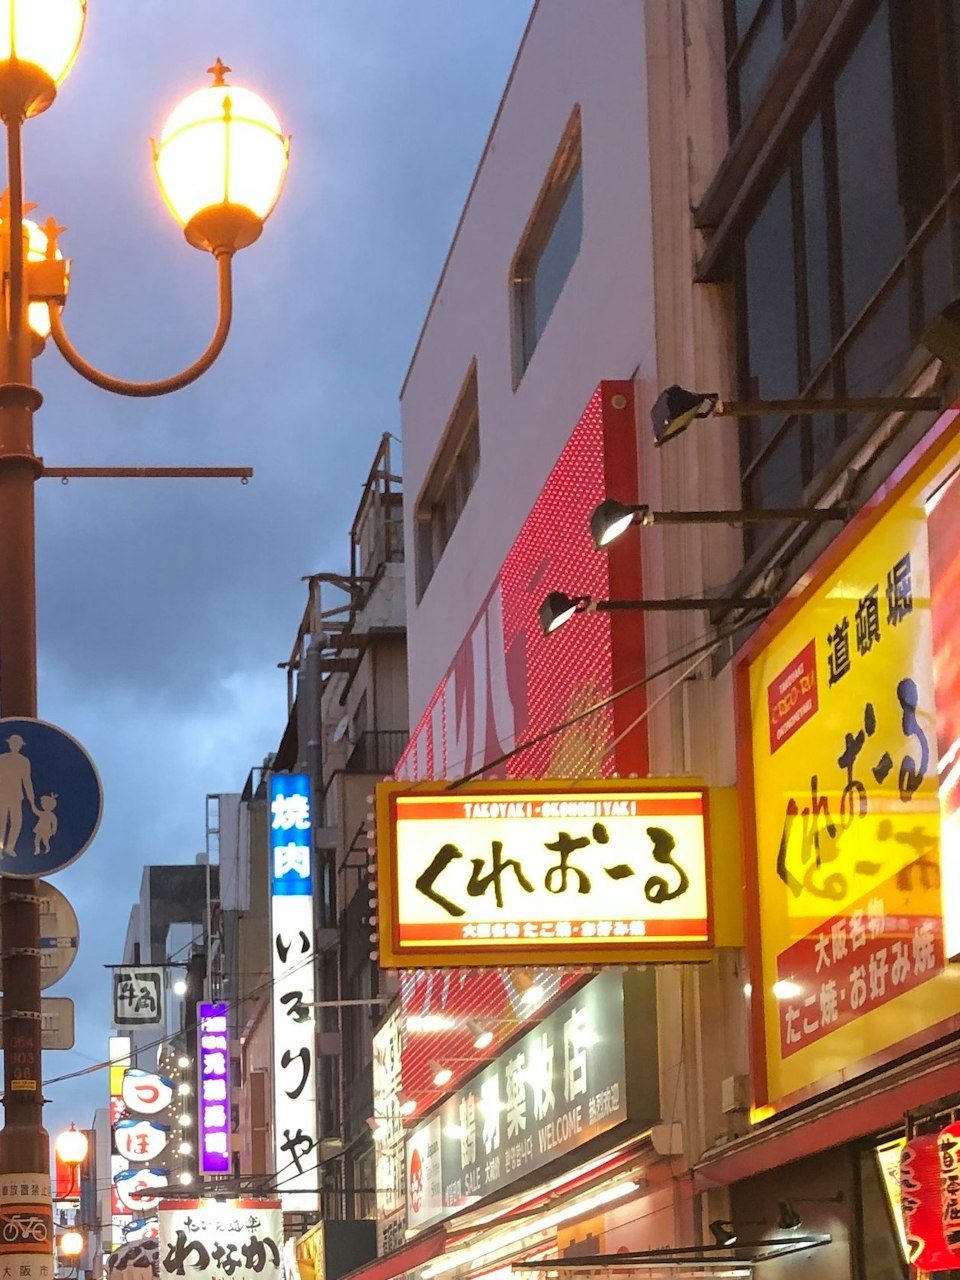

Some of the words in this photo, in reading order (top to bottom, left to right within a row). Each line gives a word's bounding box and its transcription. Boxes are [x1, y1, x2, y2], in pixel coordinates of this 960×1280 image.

[828, 552, 913, 688] 道頓堀
[271, 793, 311, 879] 焼肉
[416, 822, 690, 917] くれおーる
[813, 896, 886, 973] 大阪名物
[118, 982, 156, 1014] 牛角
[538, 1105, 583, 1153] WELCOME
[464, 1166, 481, 1196] SALE
[2, 1264, 49, 1278] 大阪市
[162, 1229, 281, 1276] わなか
